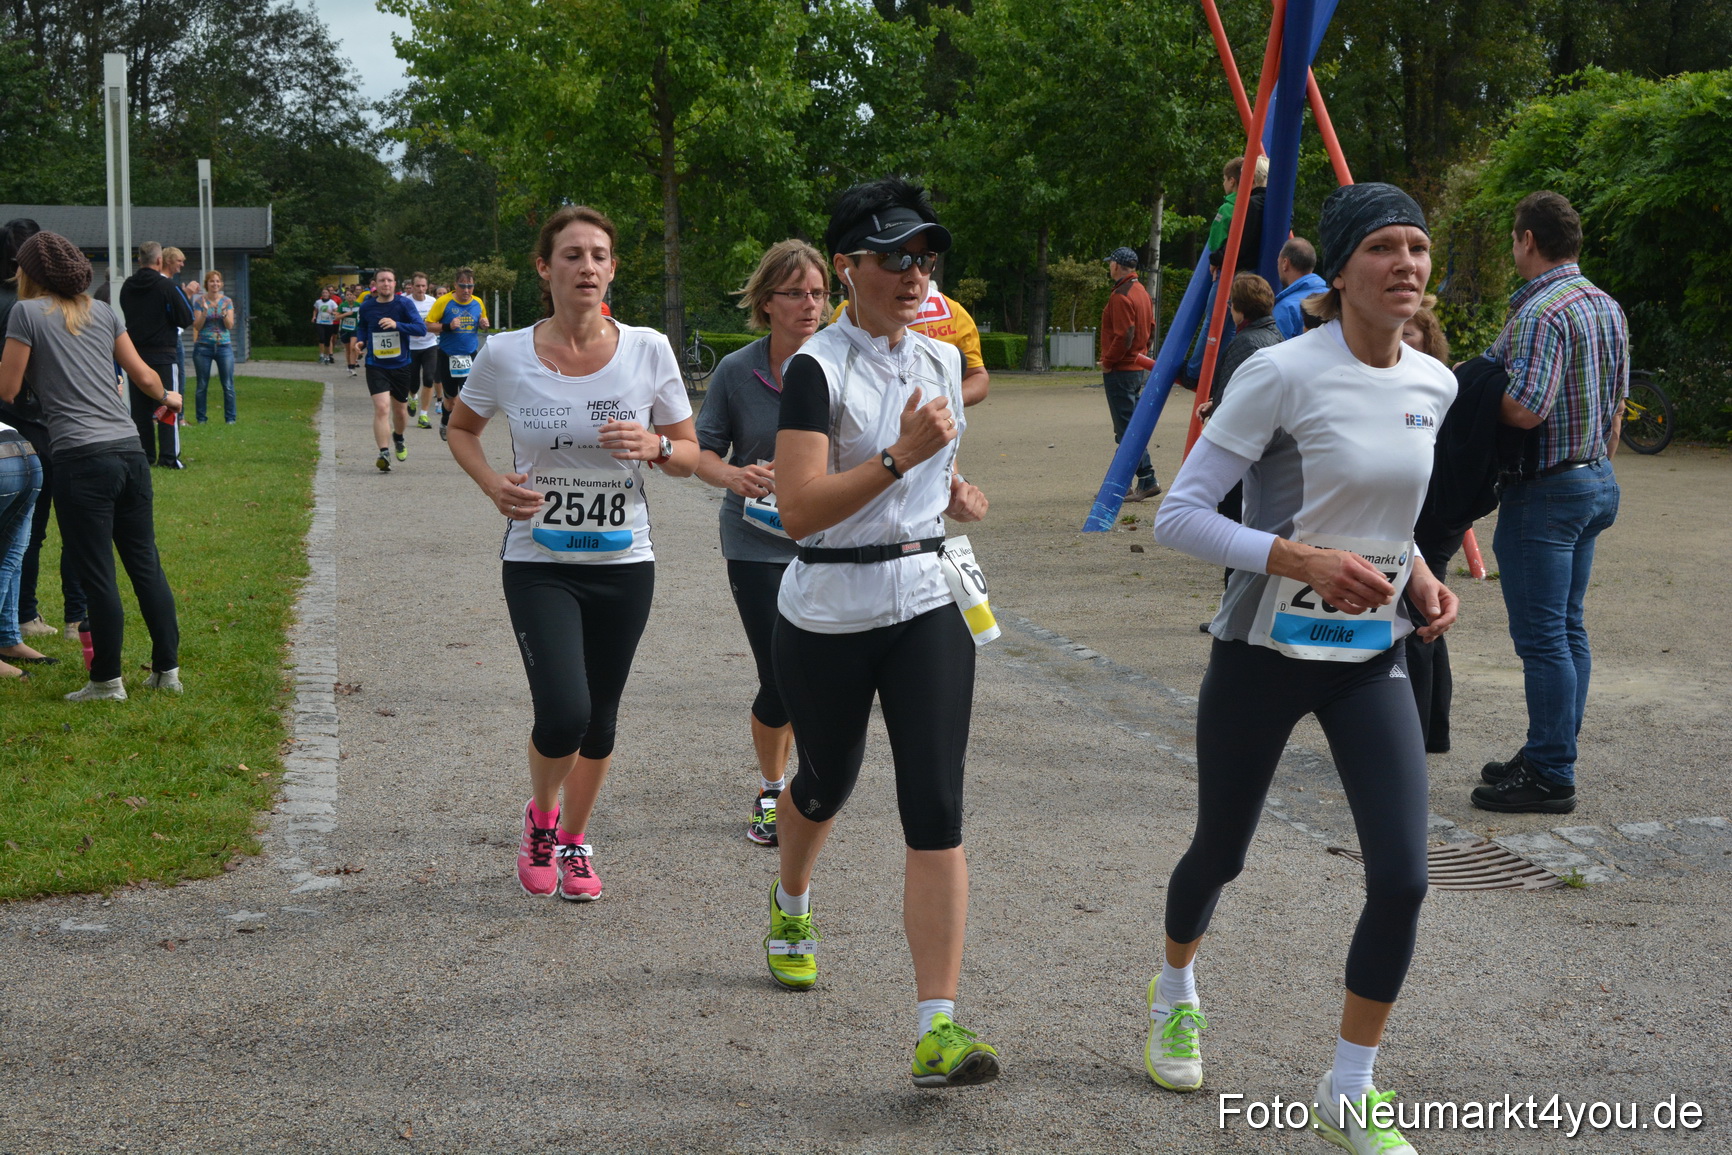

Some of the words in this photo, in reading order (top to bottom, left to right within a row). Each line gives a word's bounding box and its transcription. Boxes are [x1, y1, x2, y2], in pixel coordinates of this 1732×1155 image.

[380, 339, 393, 349] 45
[519, 406, 572, 417] PEUGEOT
[586, 400, 620, 411] HECK
[590, 410, 637, 421] DESIGN
[523, 418, 568, 430] MÜLLER
[535, 475, 570, 487] PARTL
[572, 478, 621, 489] Neumarkt
[542, 490, 626, 527] 2548
[566, 535, 599, 549] Julia
[1309, 623, 1355, 643] Ulrike
